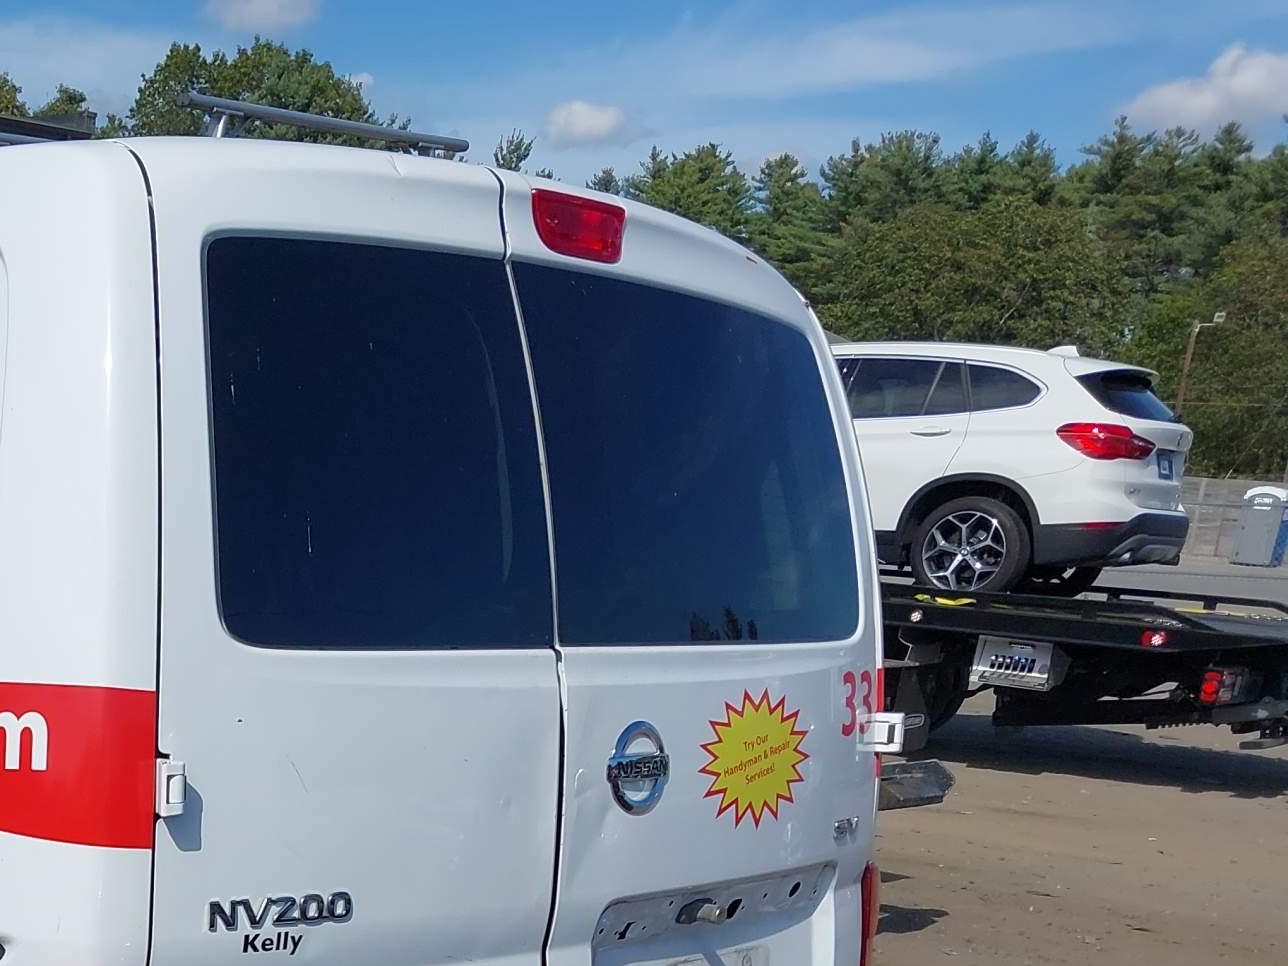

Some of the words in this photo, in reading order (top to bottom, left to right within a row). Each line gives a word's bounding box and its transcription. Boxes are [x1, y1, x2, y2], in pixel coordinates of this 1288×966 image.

[841, 670, 872, 737] 33
[743, 740, 755, 752] Try
[756, 734, 769, 746] Our
[617, 757, 667, 778] NISSAN
[723, 754, 763, 778] Handyman
[769, 741, 790, 756] Repair
[745, 762, 776, 785] Services!
[207, 890, 354, 933] NV200
[242, 931, 303, 955] Kelly
